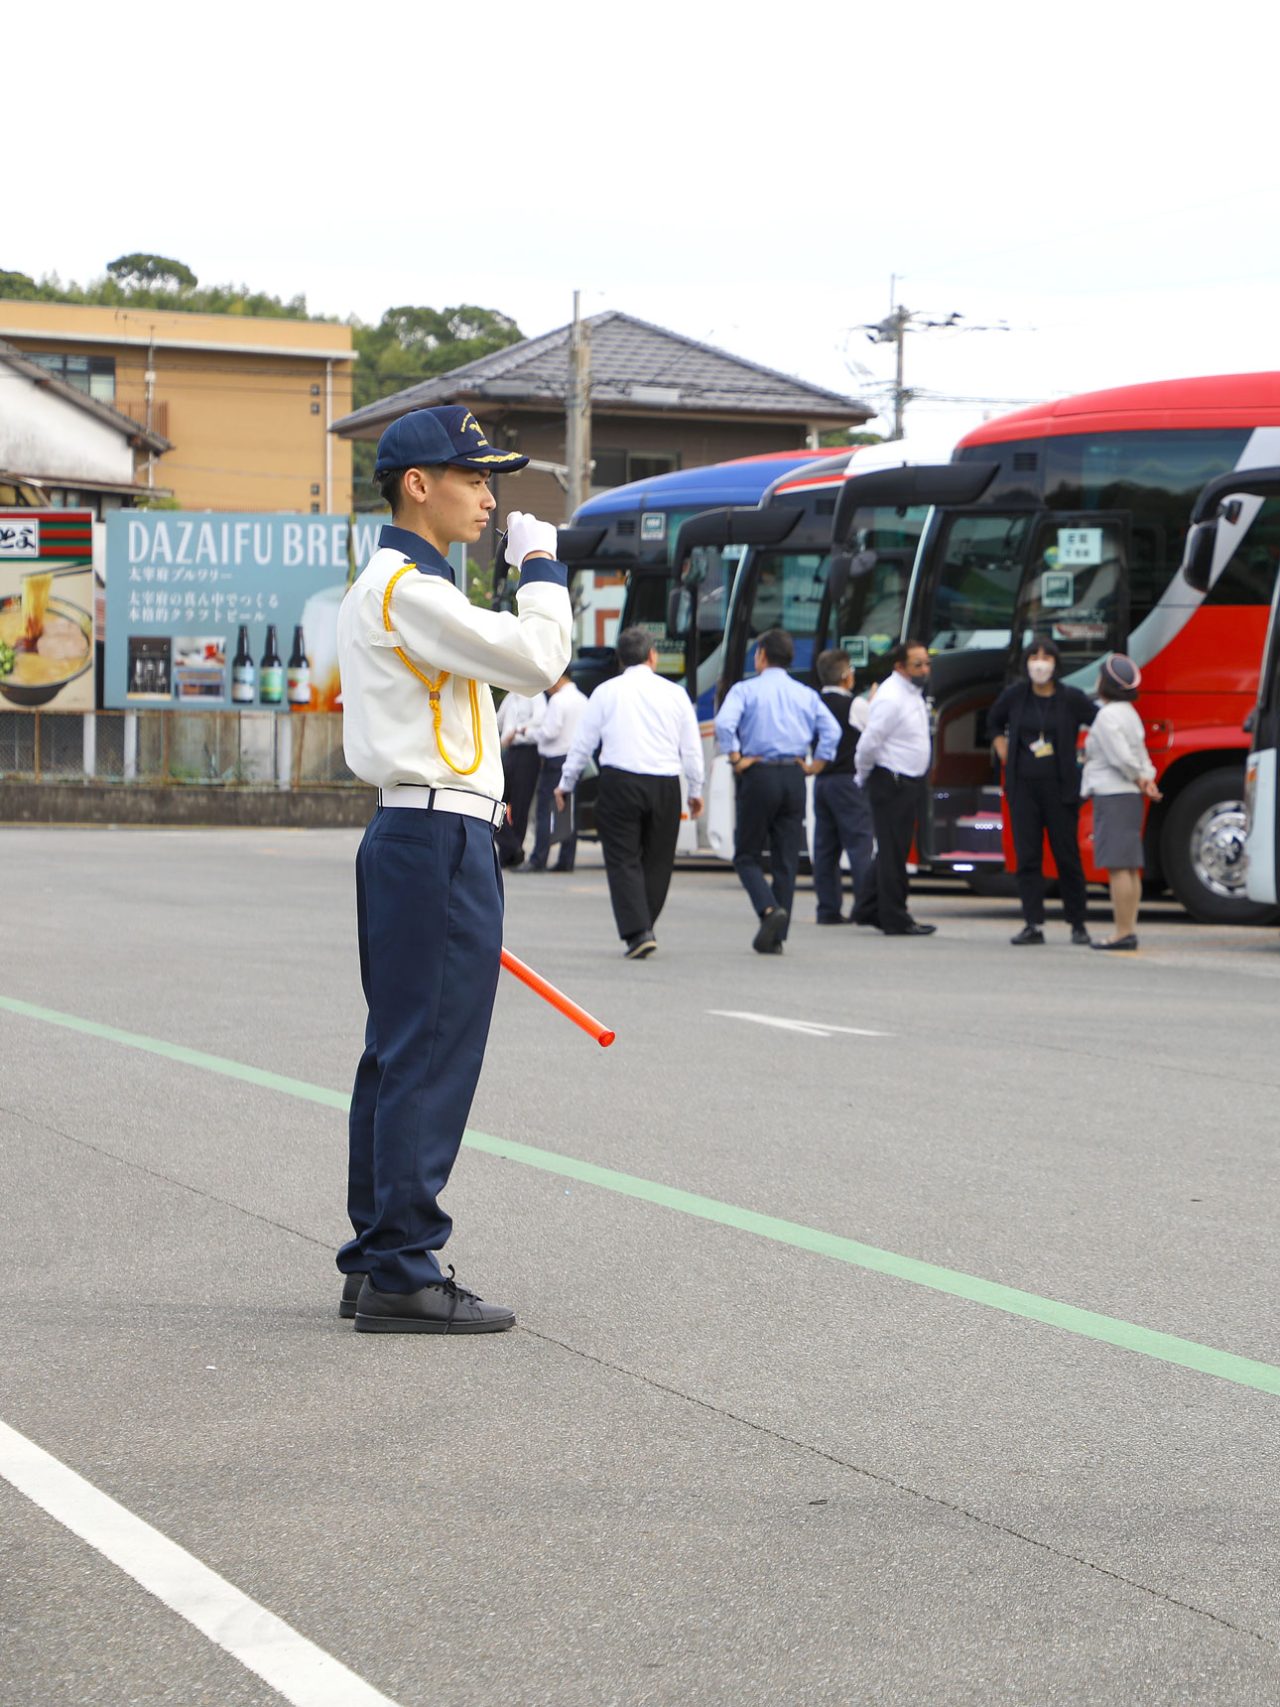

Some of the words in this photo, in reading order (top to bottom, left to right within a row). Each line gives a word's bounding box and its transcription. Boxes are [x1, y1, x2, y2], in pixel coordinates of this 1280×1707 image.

[128, 520, 272, 565] DAZAIFU
[129, 566, 232, 582] 太宰府ブルワリー
